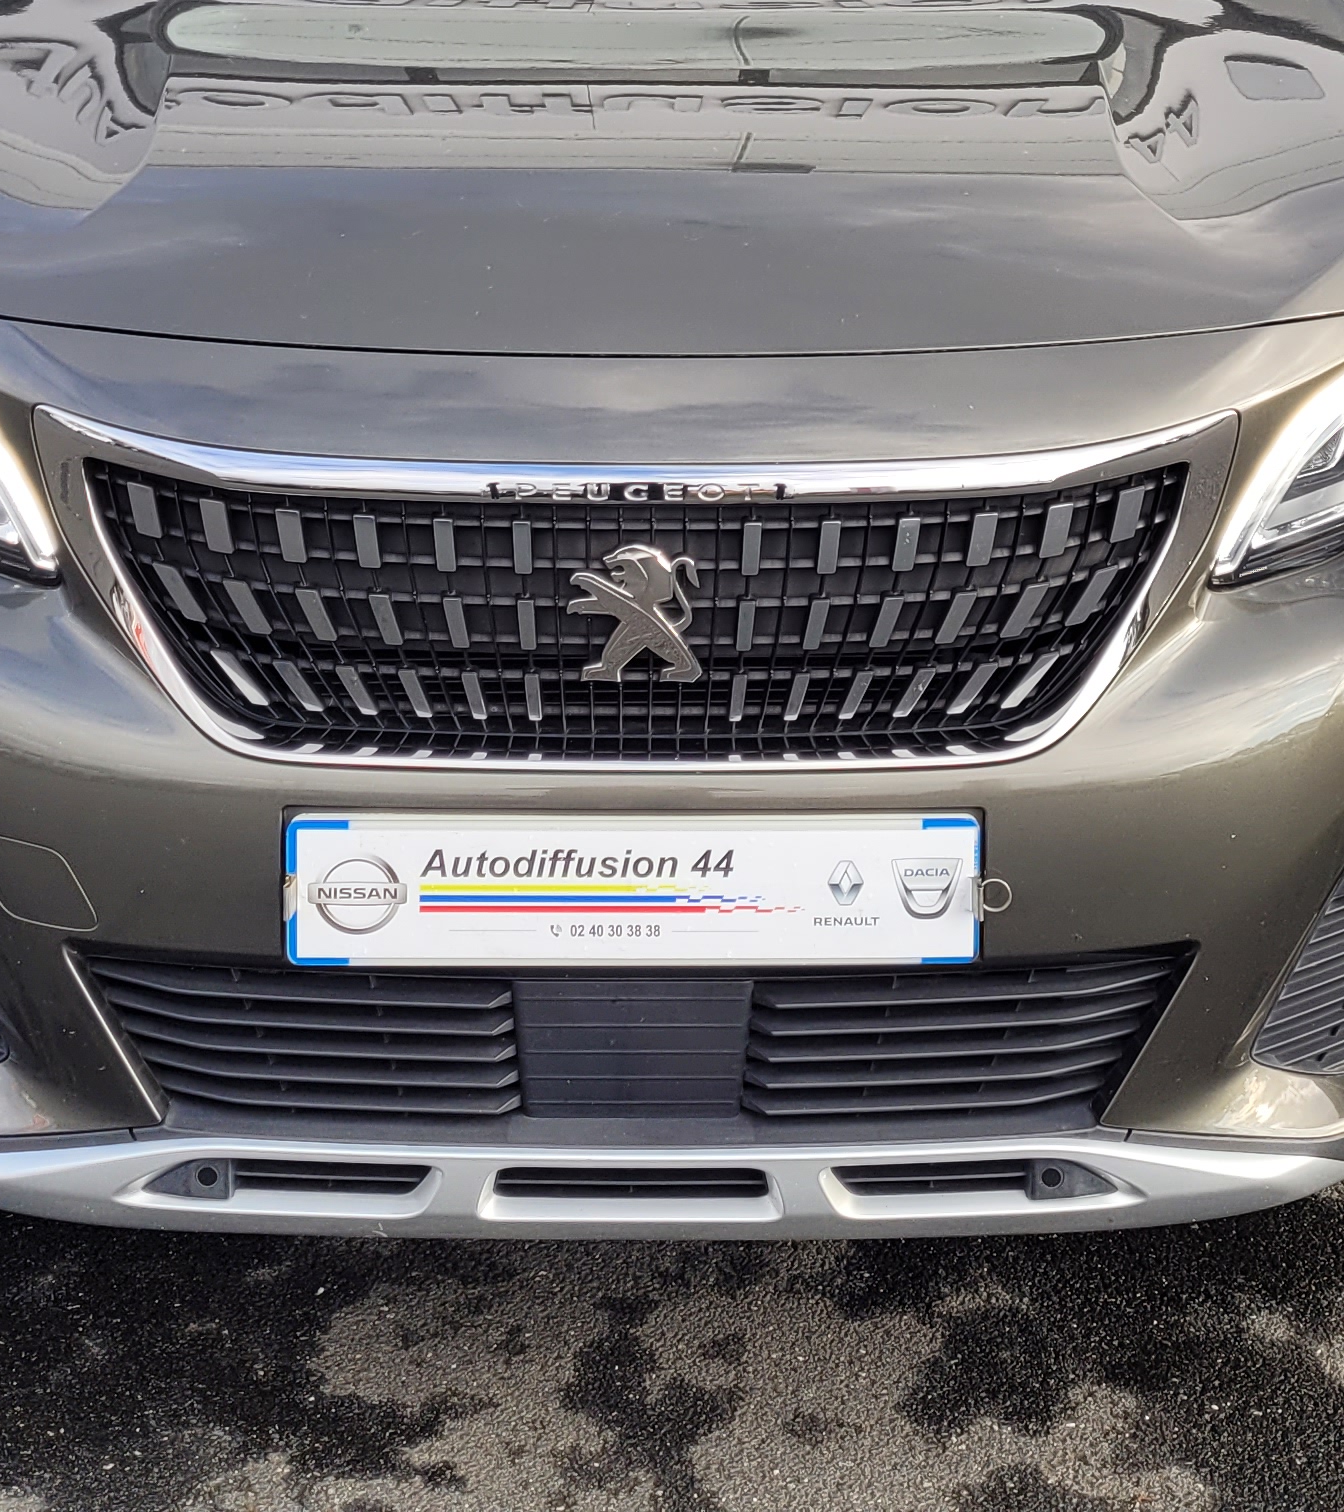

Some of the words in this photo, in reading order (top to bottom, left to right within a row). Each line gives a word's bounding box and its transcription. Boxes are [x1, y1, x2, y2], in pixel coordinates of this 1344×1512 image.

[516, 482, 760, 501] PEUGEOT
[420, 848, 679, 879] Autodiffusion
[691, 848, 735, 879] 44
[903, 867, 950, 877] DACIA
[317, 887, 398, 900] NISSAN
[813, 916, 880, 927] RENAULT
[569, 924, 586, 937] 02
[588, 924, 604, 937] 40
[607, 924, 623, 937] 30
[626, 924, 642, 937] 38
[645, 924, 661, 937] 38
